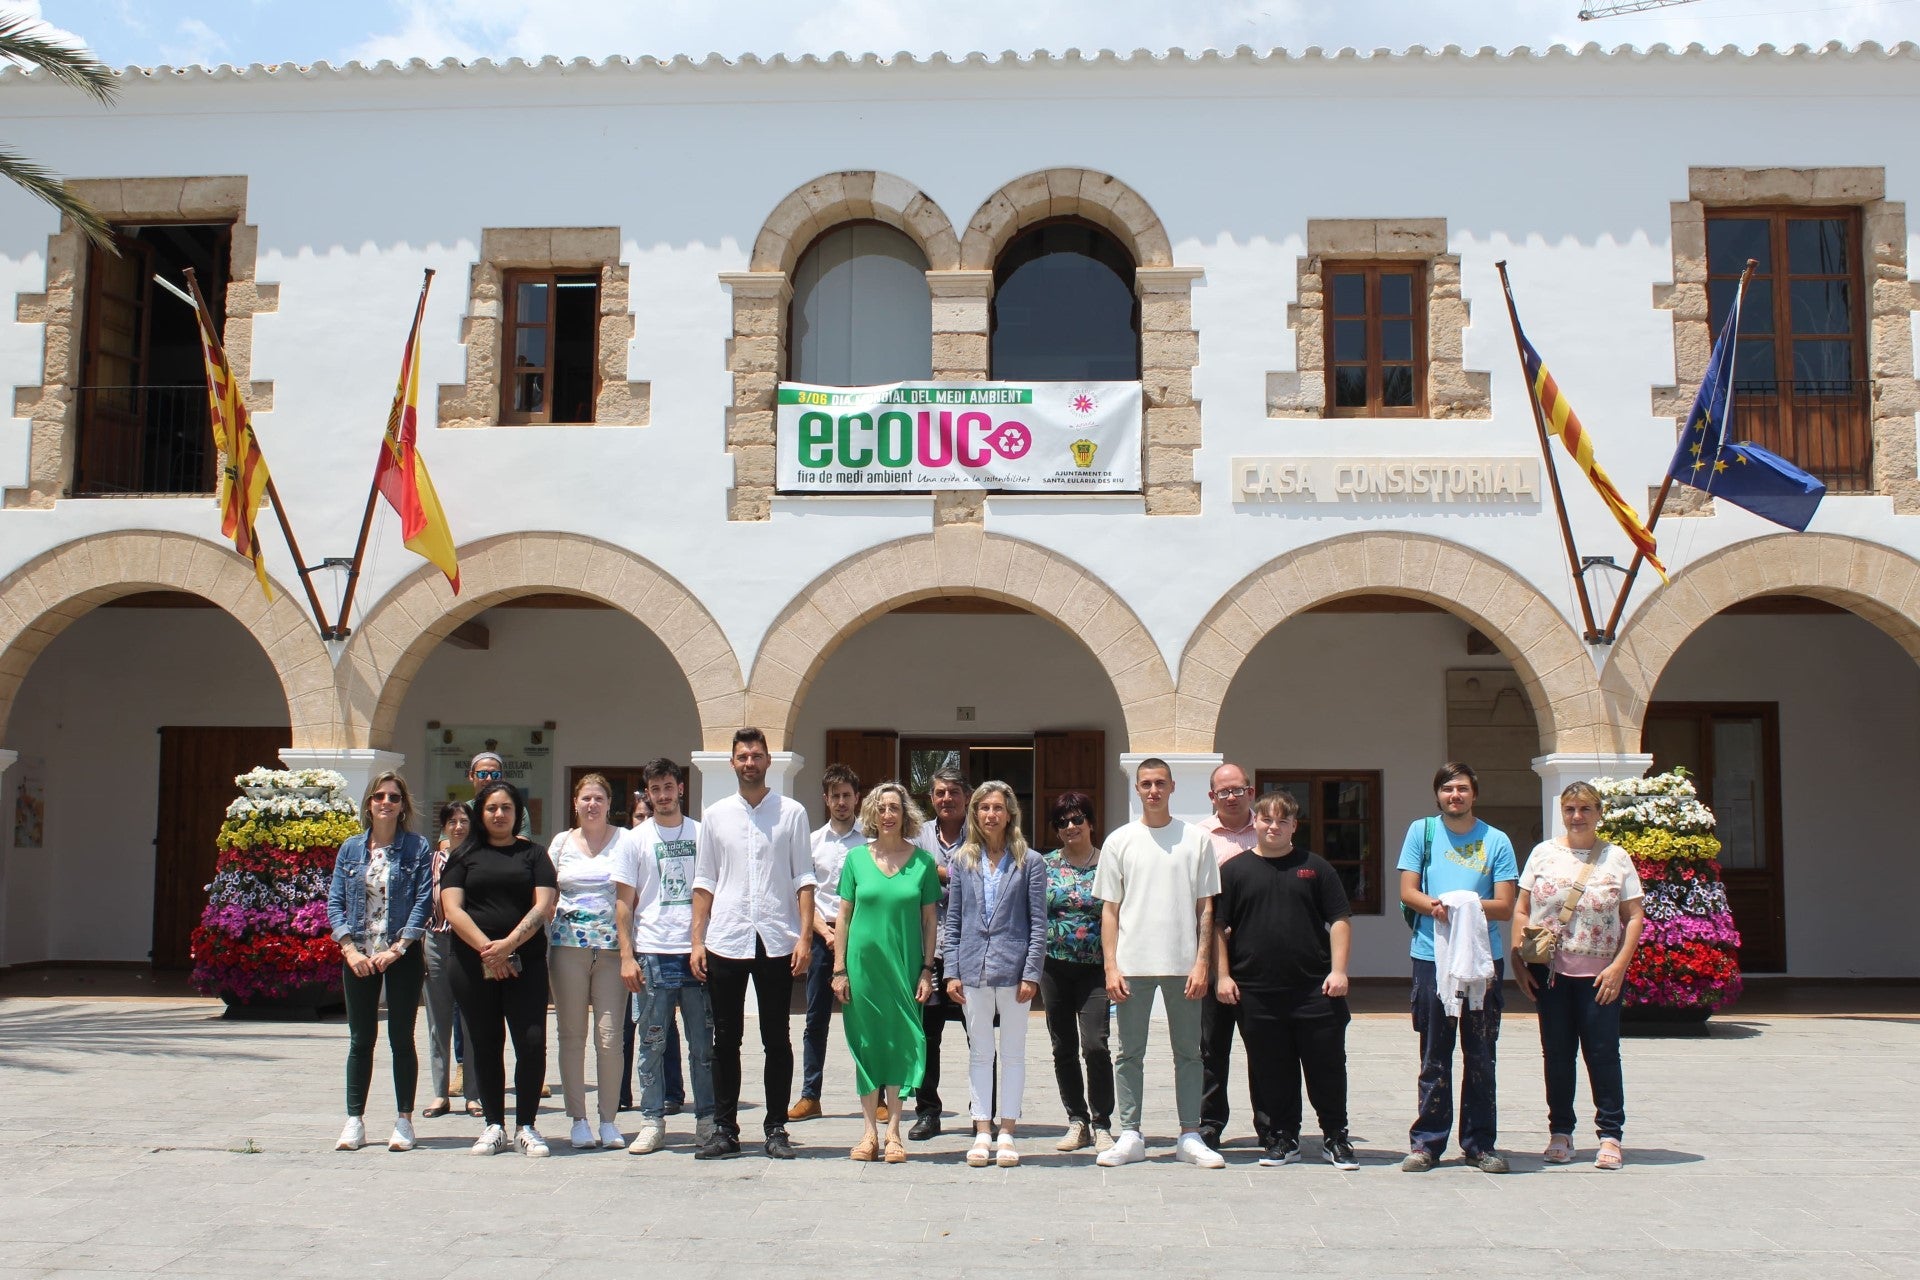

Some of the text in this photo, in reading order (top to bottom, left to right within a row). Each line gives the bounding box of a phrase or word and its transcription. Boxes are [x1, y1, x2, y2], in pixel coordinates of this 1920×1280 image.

[798, 391, 828, 405] 3/06
[911, 390, 933, 404] DEL
[935, 390, 966, 404] MEDI
[969, 390, 1023, 404] AMBIENT
[797, 469, 913, 484] fira de medi ambient
[917, 473, 937, 483] Una
[940, 472, 960, 483] crida
[972, 475, 981, 483] la
[983, 472, 1032, 484] sostenibilitat
[1240, 463, 1533, 494] CASA CONSISTORIAL
